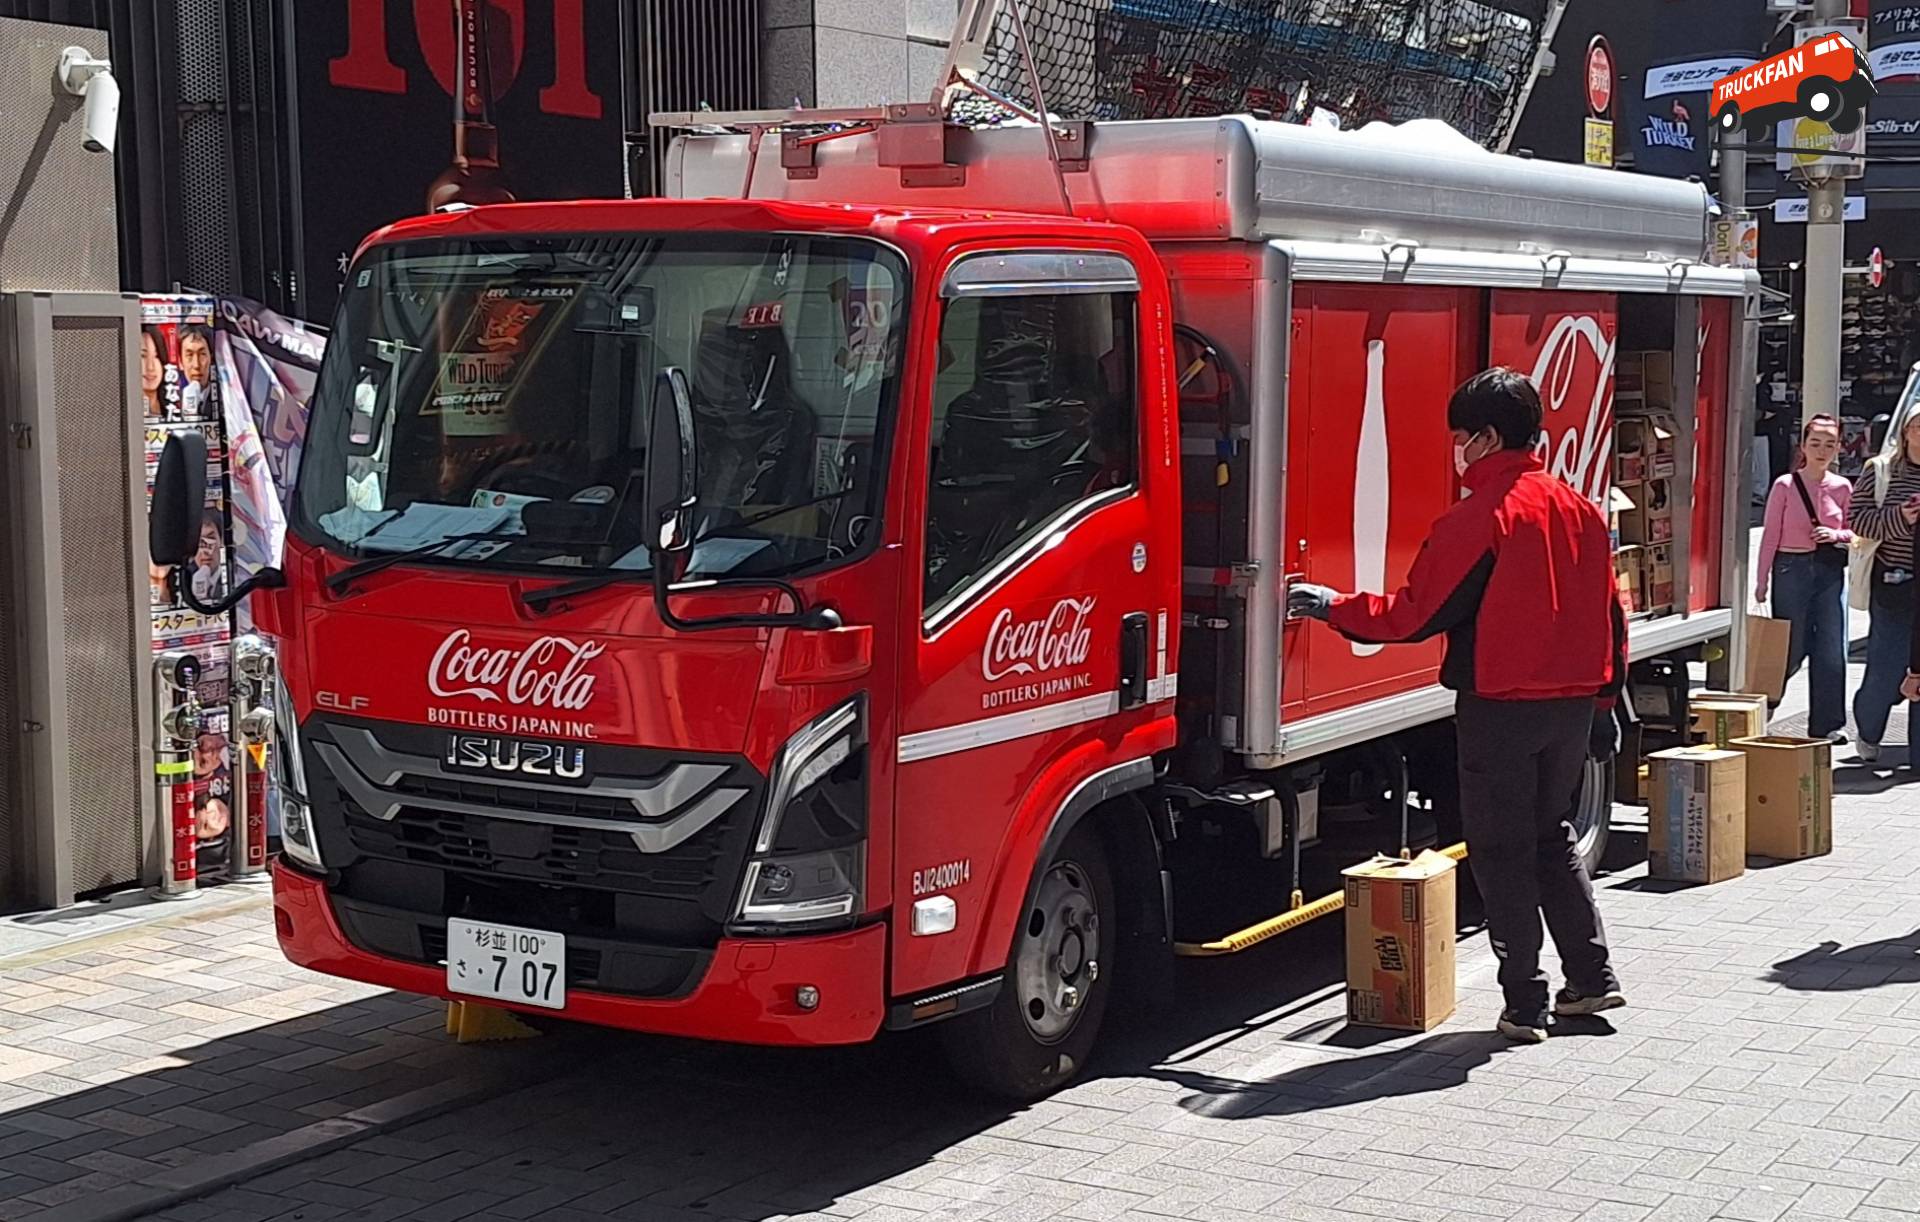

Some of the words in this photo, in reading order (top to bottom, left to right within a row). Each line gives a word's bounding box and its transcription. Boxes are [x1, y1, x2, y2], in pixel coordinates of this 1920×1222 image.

[1640, 126, 1696, 151] TURKEY
[1647, 115, 1689, 138] WILD
[164, 363, 182, 423] あなた
[980, 593, 1098, 681] Coca-Cola
[427, 628, 607, 711] Coca-Cola
[315, 690, 369, 711] ELF
[981, 683, 1039, 710] BOTTLERS
[1040, 677, 1072, 699] JAPAN
[1073, 672, 1093, 692] INC.
[427, 707, 508, 731] BOTTLERS
[511, 716, 561, 736] JAPAN
[565, 720, 598, 739] INC.
[447, 734, 585, 779] ISUZU
